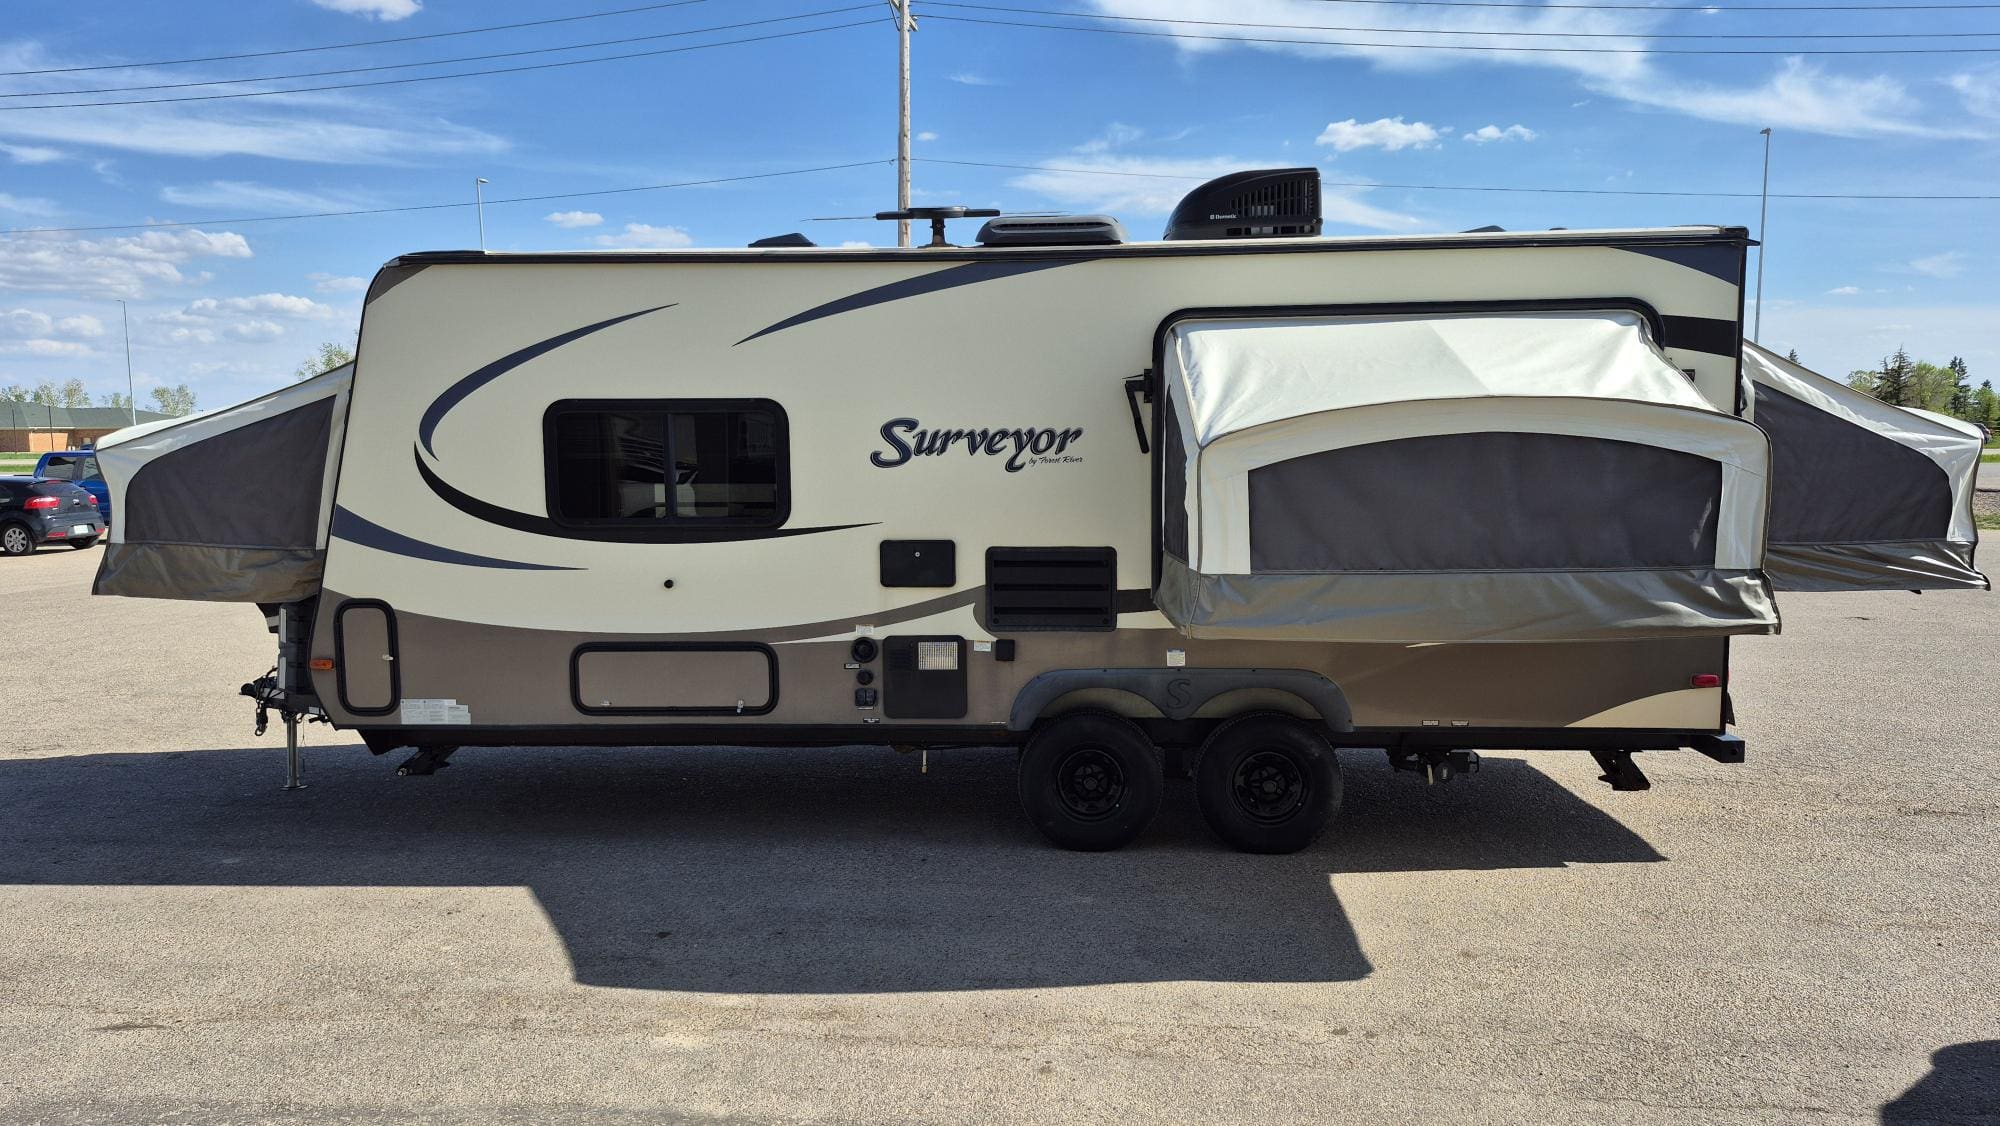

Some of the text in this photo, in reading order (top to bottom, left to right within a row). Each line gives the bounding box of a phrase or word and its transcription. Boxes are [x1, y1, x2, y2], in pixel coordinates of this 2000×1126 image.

[870, 417, 1084, 473] Surveyor
[1028, 456, 1083, 467] by Forest River
